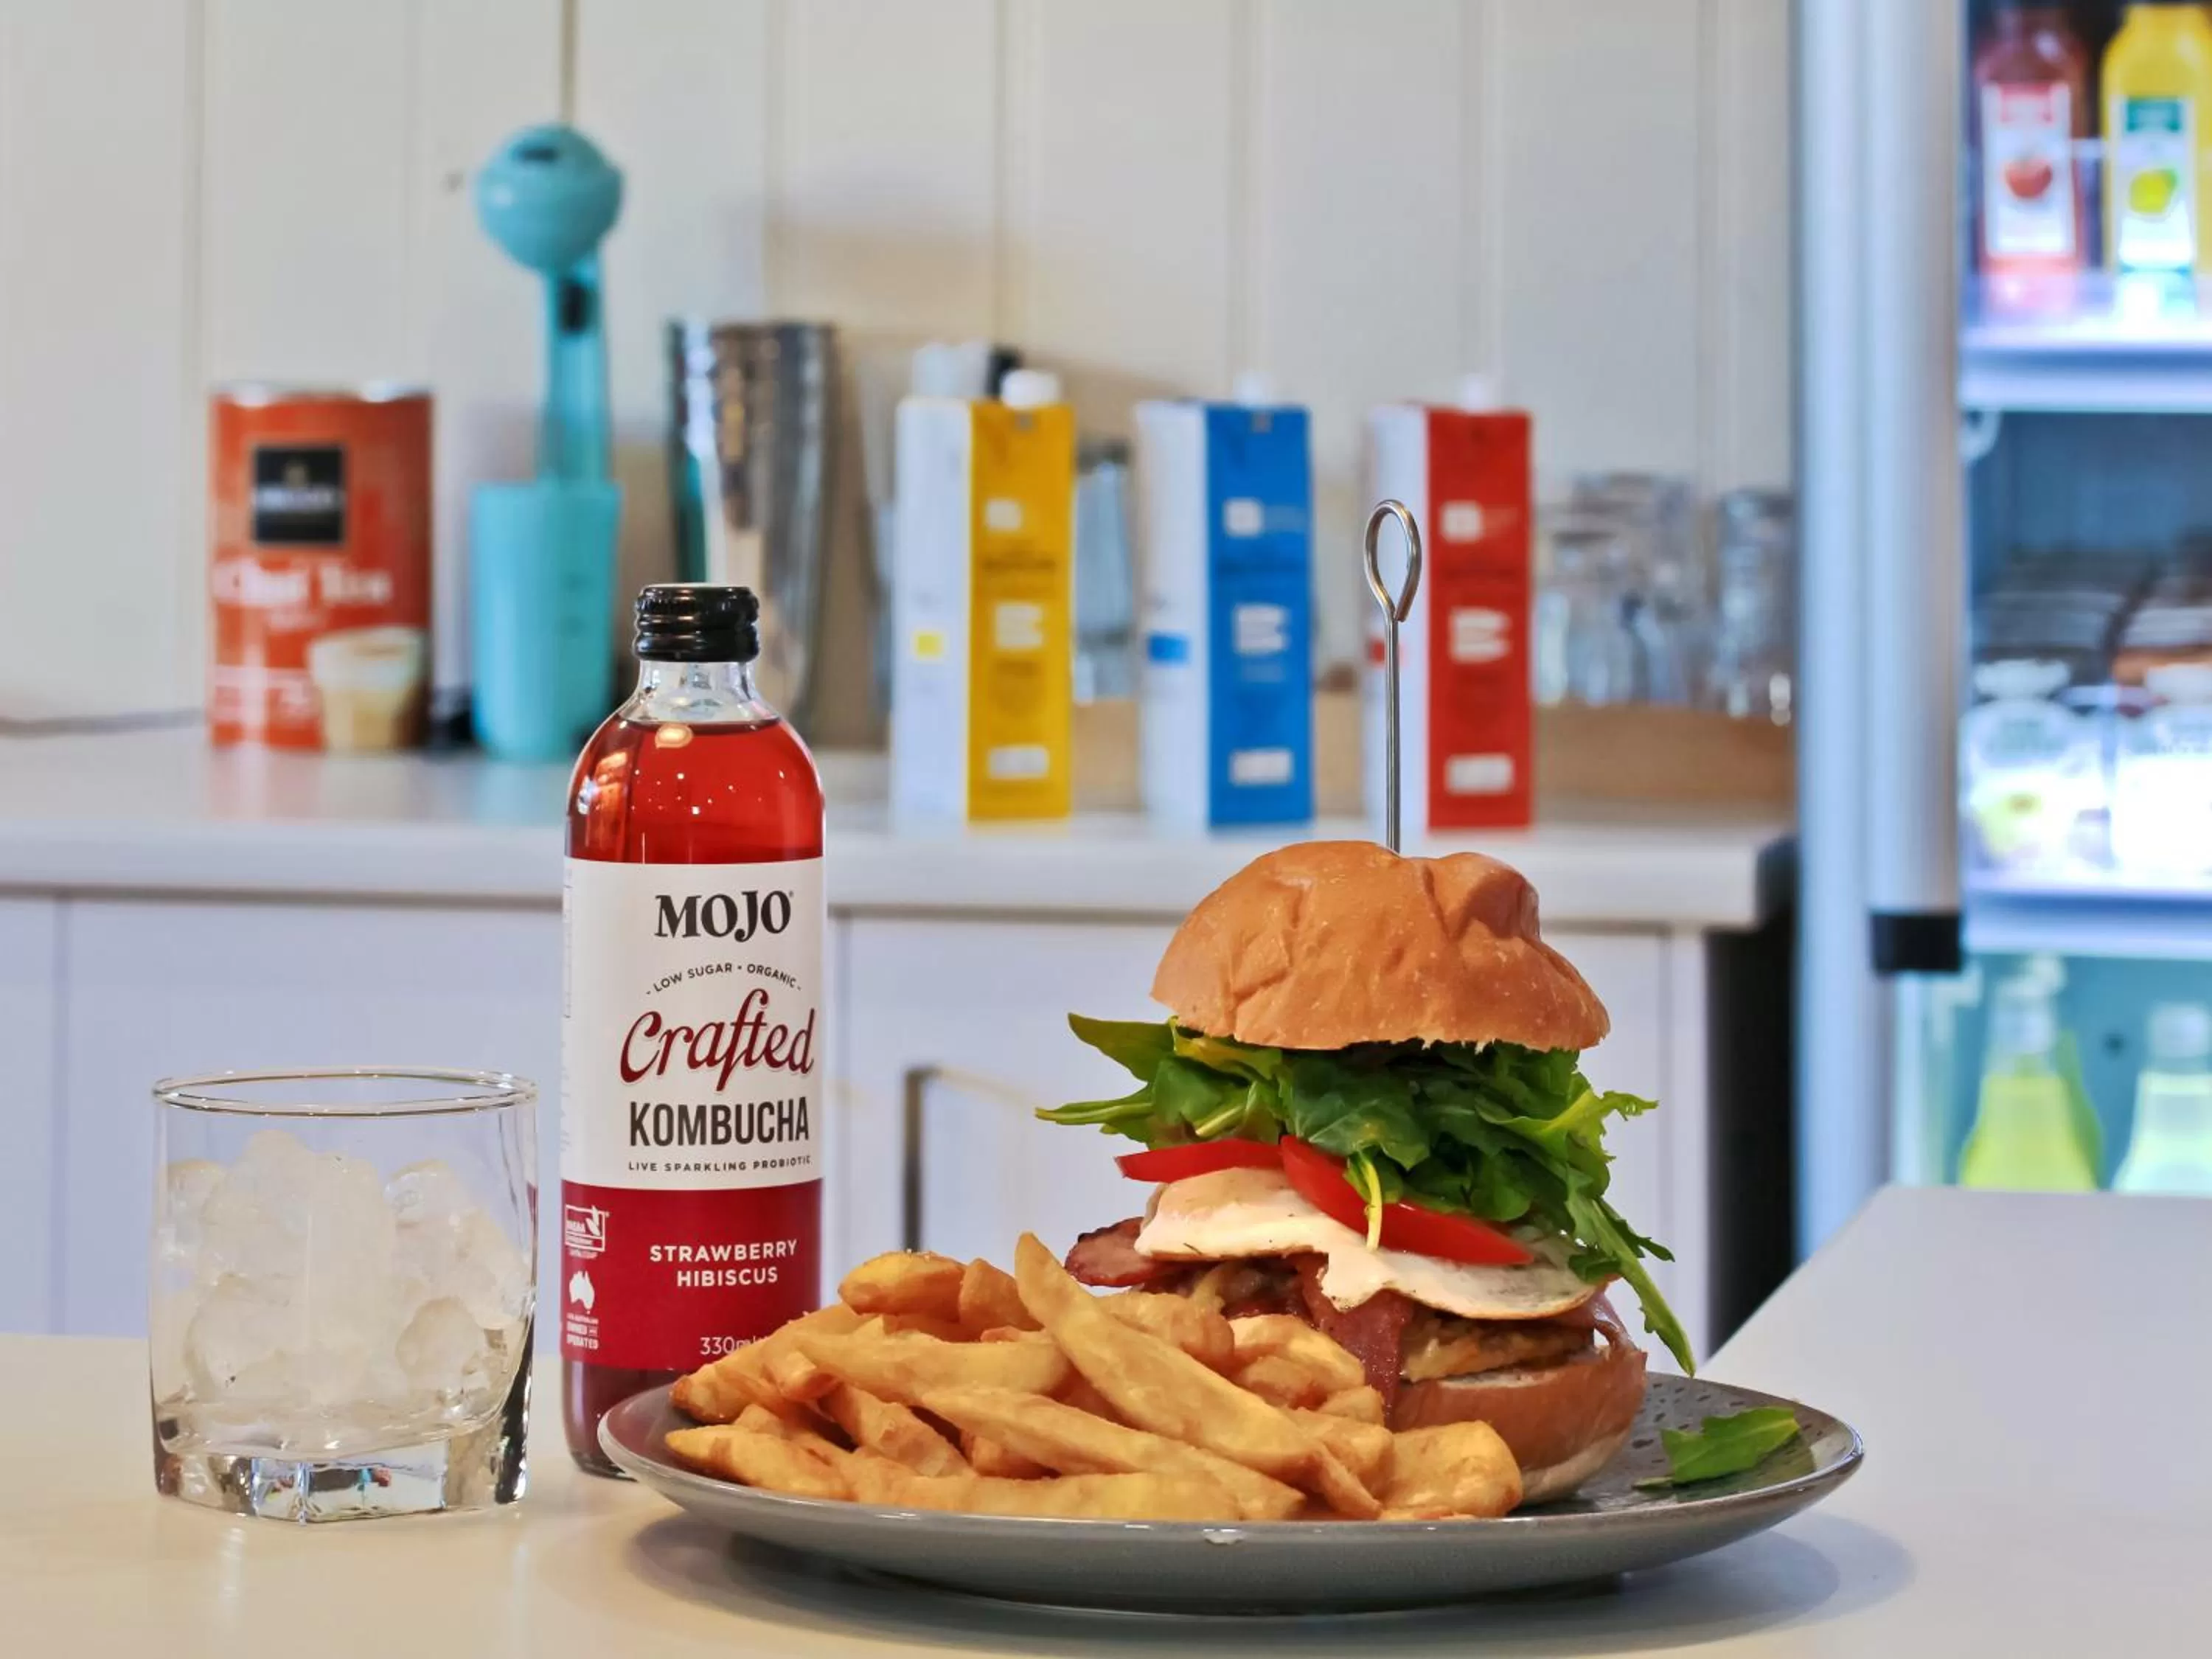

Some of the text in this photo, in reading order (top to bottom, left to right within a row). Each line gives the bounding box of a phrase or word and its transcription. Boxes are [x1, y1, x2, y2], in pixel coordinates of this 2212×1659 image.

[654, 890, 791, 943] MOJO
[653, 962, 797, 992] LOW SUGAR ORGANIC
[620, 988, 815, 1091] Crafted
[630, 1096, 810, 1147] KOMBUCHA
[628, 1155, 810, 1172] LIVE SPARKLING PROBIOTIC
[650, 1239, 798, 1262] STRAWBERRY
[677, 1267, 779, 1287] HIBISCUS
